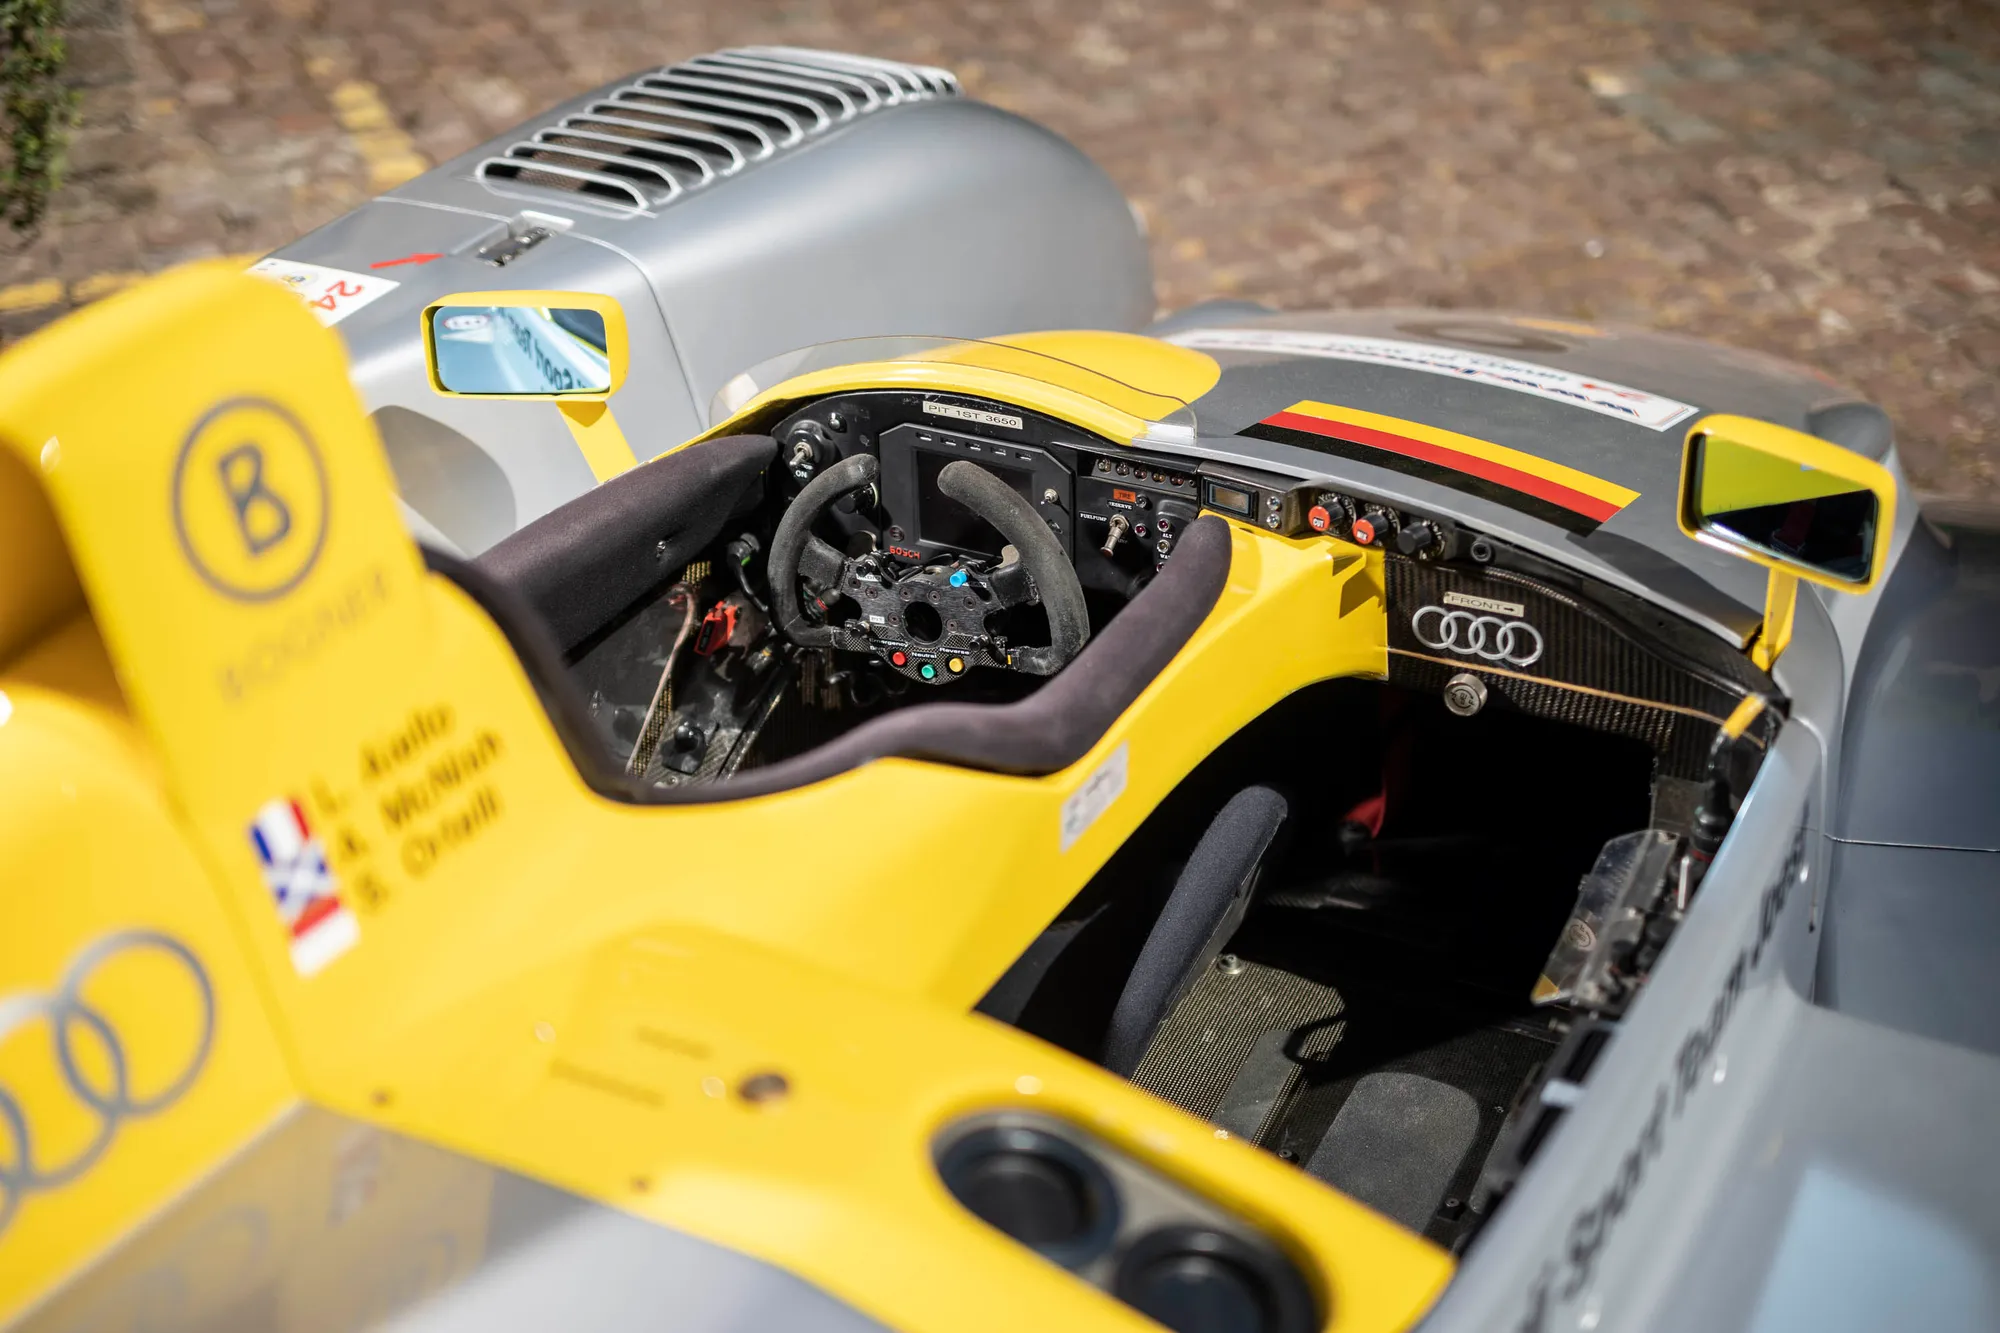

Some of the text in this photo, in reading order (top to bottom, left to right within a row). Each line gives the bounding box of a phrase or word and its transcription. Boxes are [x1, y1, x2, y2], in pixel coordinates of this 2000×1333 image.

[928, 404, 1017, 426] PIT 1ST 3650
[795, 469, 807, 479] ON
[217, 441, 293, 558] B
[889, 545, 920, 560] BOSCH
[1451, 596, 1501, 610] FRONT
[911, 651, 937, 659] Neutral
[939, 647, 970, 655] Reverse
